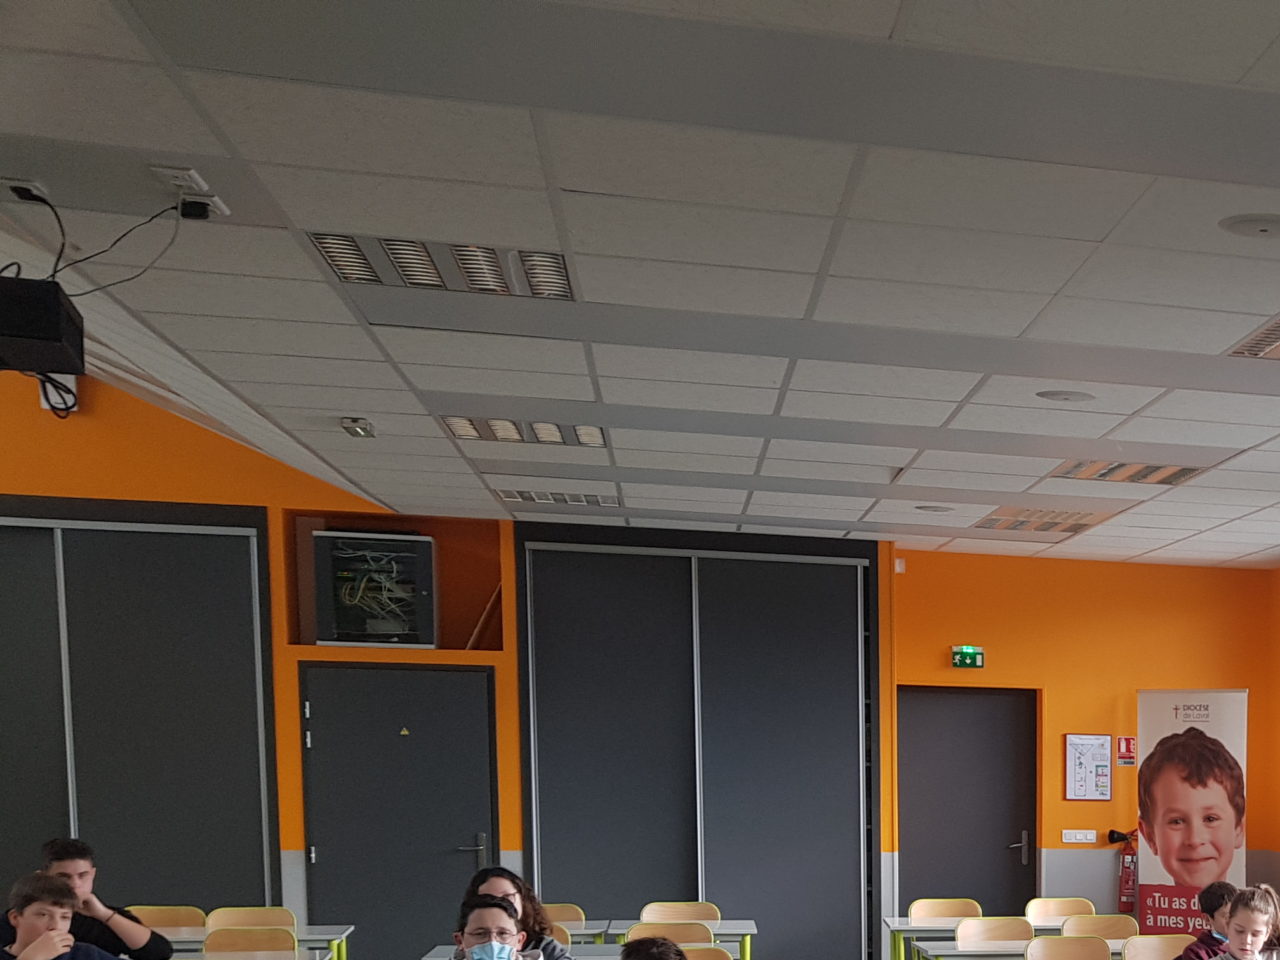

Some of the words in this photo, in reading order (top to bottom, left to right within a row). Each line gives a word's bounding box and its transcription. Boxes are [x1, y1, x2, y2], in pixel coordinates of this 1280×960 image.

[1172, 897, 1187, 910] as
[1146, 910, 1154, 926] à
[1157, 915, 1184, 928] mes
[1187, 917, 1214, 933] yeu
